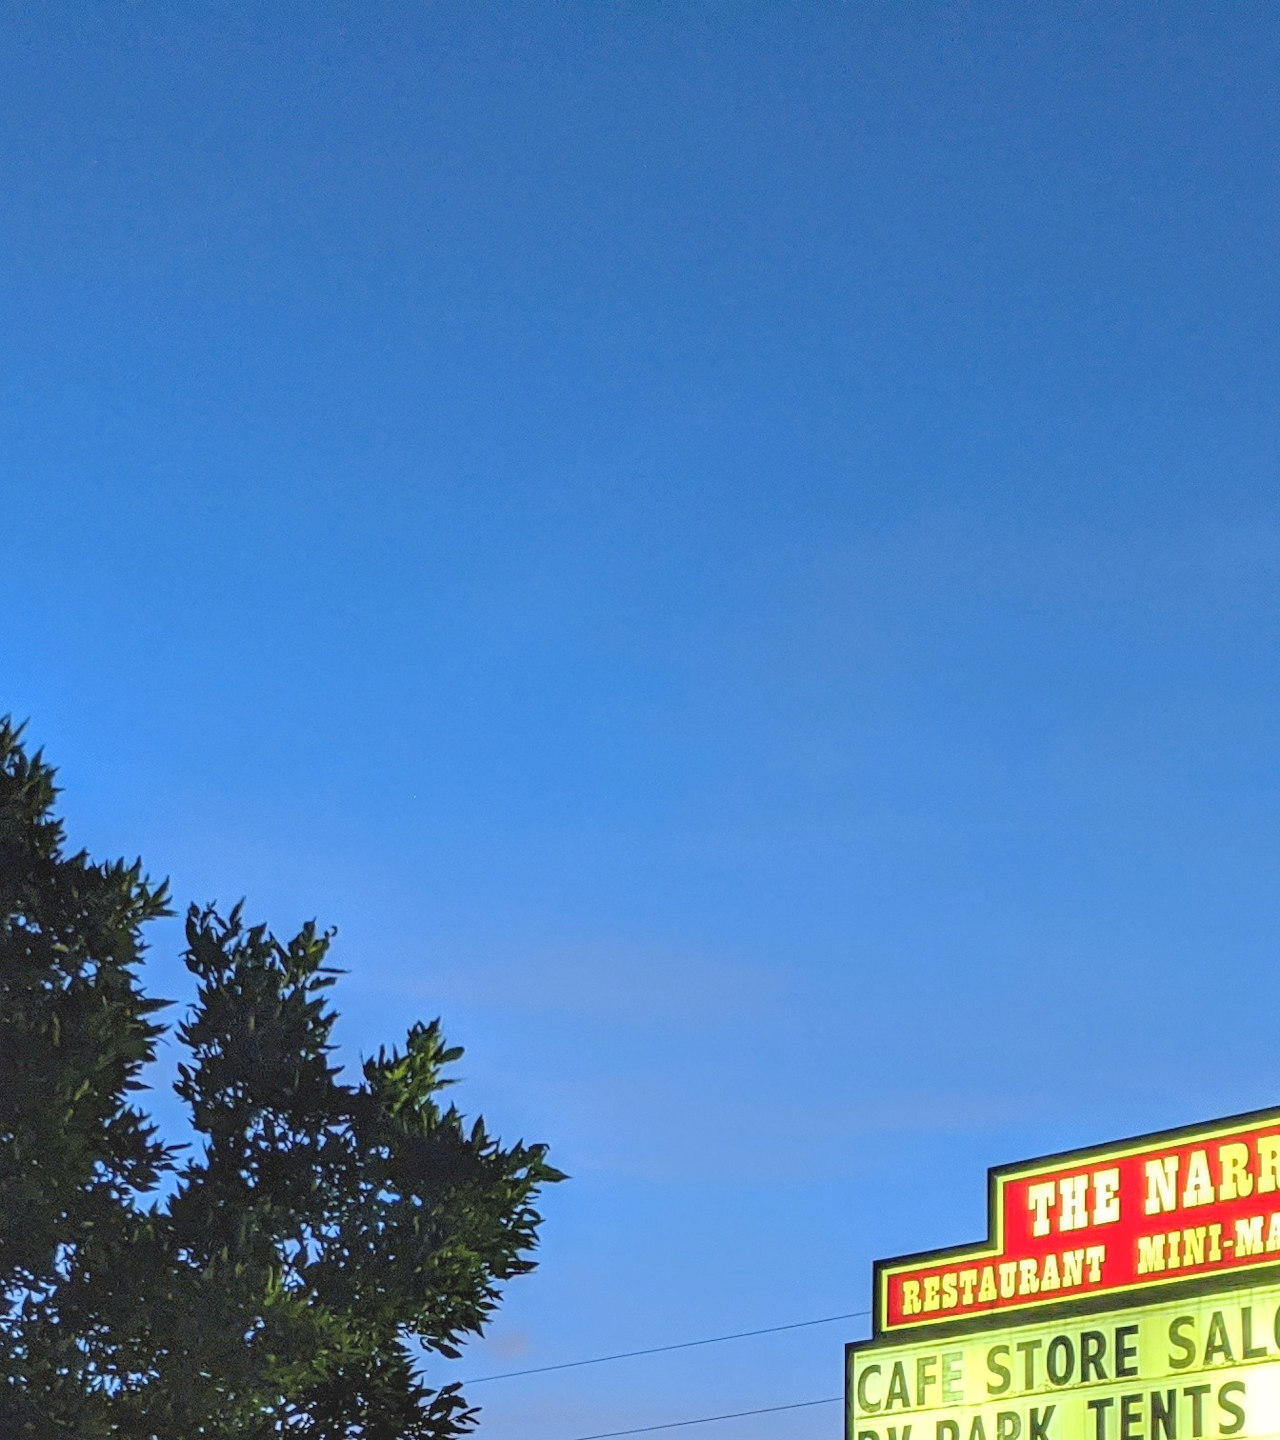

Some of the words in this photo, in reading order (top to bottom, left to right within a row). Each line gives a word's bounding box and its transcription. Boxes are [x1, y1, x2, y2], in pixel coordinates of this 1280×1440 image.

[1028, 1167, 1120, 1238] THE
[902, 1245, 1105, 1316] RESTAURANT
[857, 1350, 964, 1413] CAFE
[986, 1325, 1139, 1396] STORE
